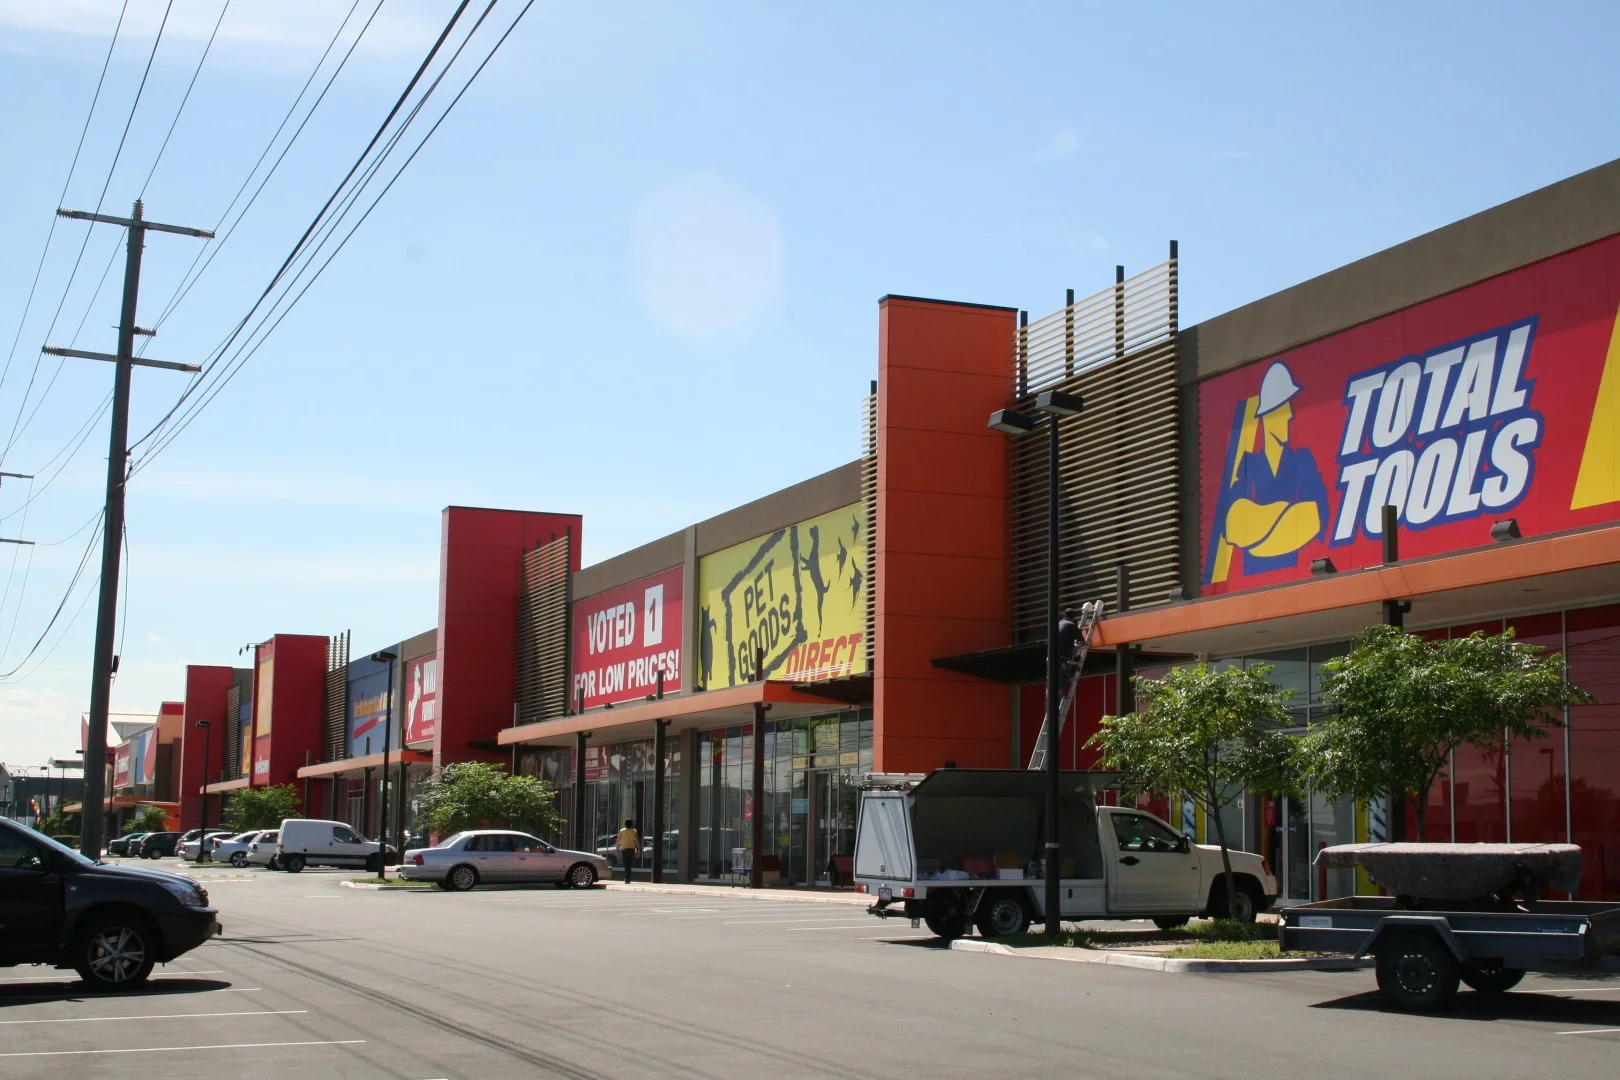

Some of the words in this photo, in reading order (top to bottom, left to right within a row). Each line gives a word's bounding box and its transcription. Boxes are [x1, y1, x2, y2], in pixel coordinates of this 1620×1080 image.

[1341, 324, 1532, 456] TOTAL
[1334, 417, 1539, 541] TOOLS
[588, 601, 635, 655] VOTED
[744, 558, 774, 628] PET
[738, 592, 790, 681] GOODS
[785, 633, 863, 682] DIRECT
[574, 669, 596, 701] FOR
[599, 662, 625, 695] LOW
[628, 649, 679, 690] PRICES!
